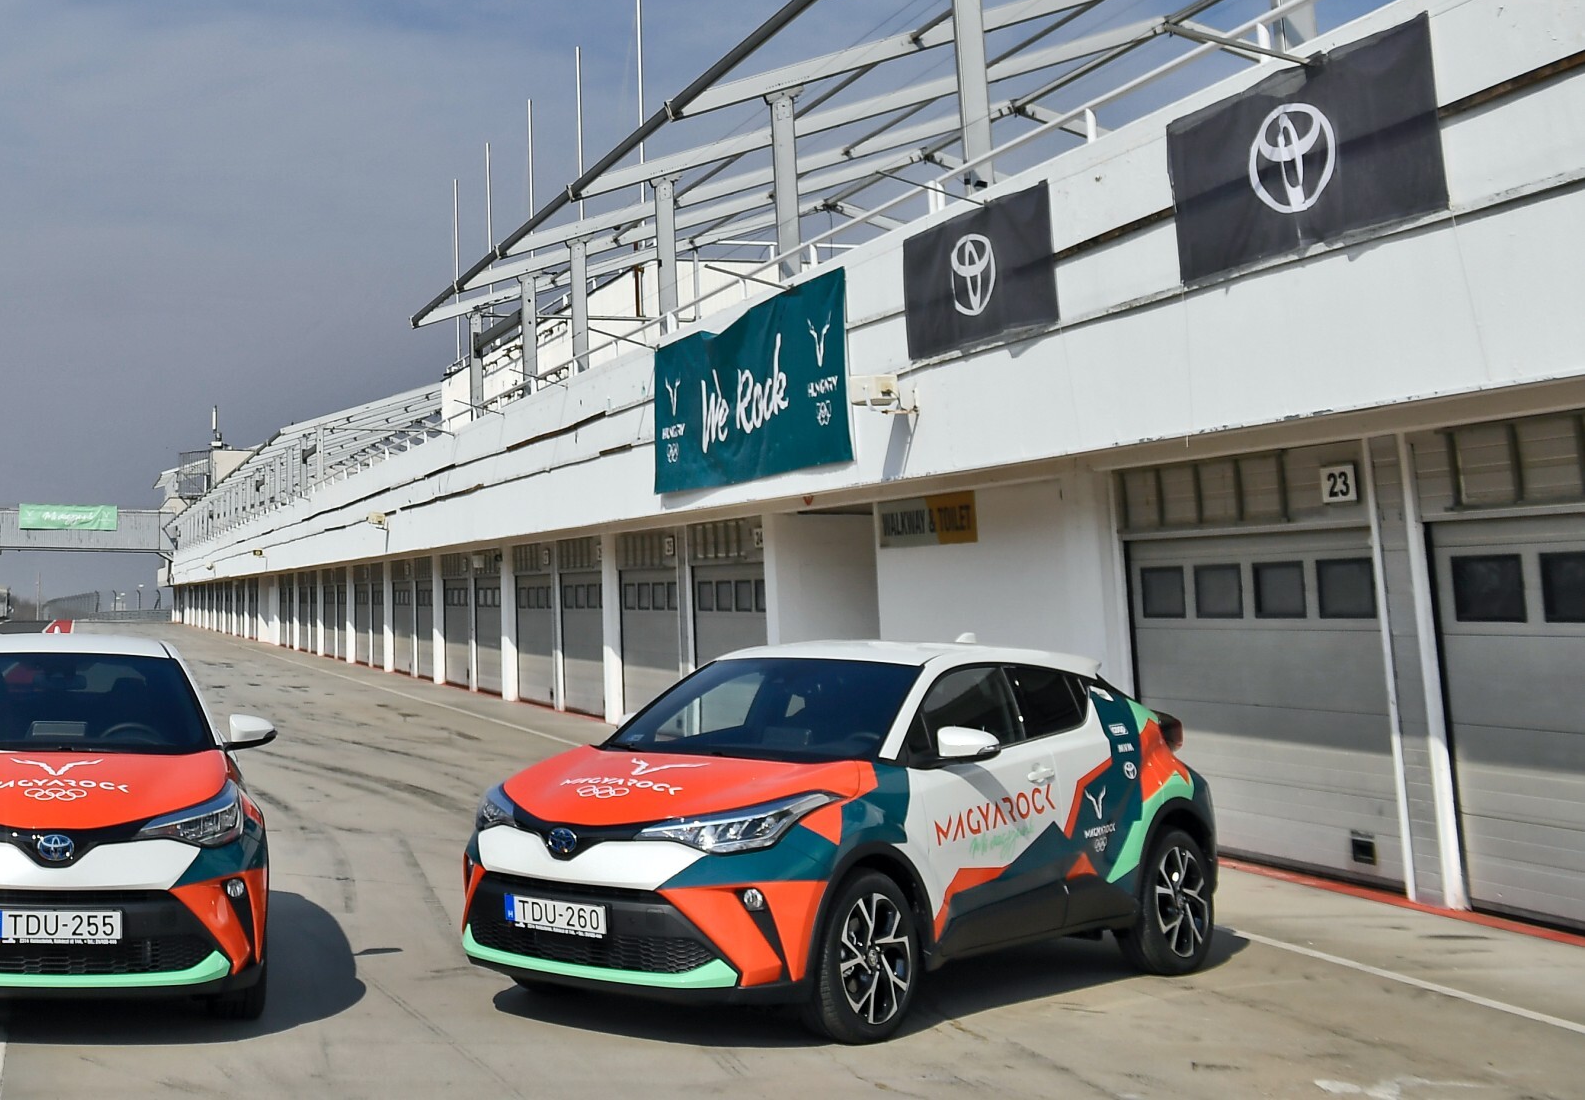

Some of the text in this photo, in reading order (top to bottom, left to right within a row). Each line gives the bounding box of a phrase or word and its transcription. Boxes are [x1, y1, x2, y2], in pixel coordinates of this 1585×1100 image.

[701, 333, 789, 453] We Rock
[808, 375, 838, 398] HUNGARY
[1327, 471, 1350, 497] 23
[882, 510, 925, 536] WALKWAY
[937, 504, 971, 532] TOILET
[8, 914, 114, 936] TDU-255
[507, 910, 513, 918] H
[518, 900, 599, 930] TDU-260
